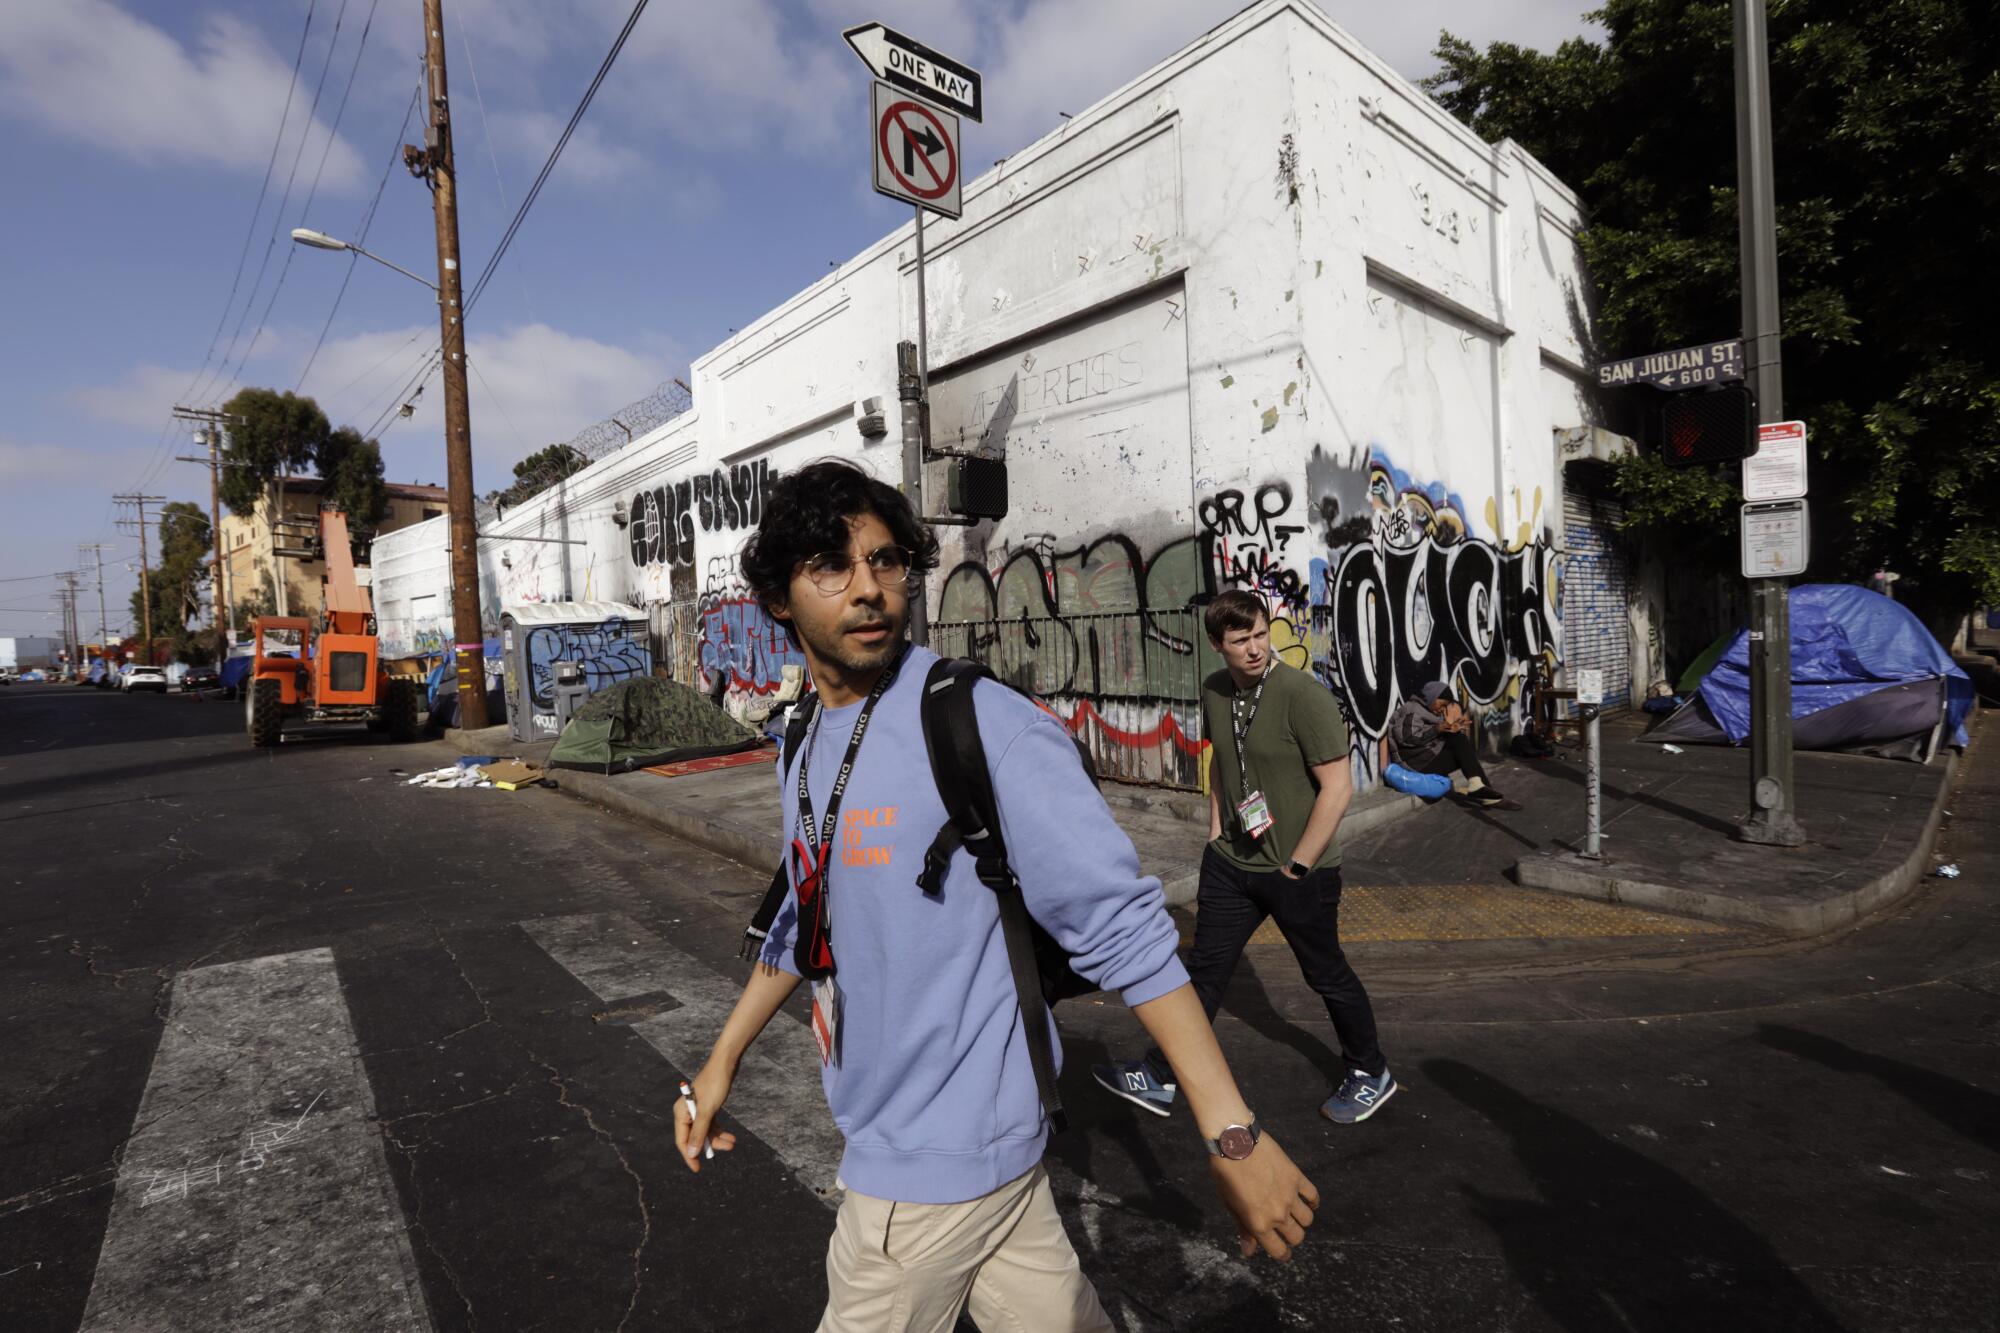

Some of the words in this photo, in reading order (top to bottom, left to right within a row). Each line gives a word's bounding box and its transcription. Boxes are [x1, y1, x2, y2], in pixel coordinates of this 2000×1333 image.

[889, 48, 926, 81] ONE
[933, 66, 969, 99] WAY
[1600, 362, 1634, 383] SAN
[1639, 348, 1704, 377] JULIAN
[1711, 342, 1741, 363] ST.
[1681, 366, 1715, 384] 600
[872, 670, 893, 698] DMH
[851, 713, 868, 745] DMH
[834, 763, 851, 796] DMH
[803, 814, 816, 846] DMH
[1125, 1071, 1148, 1091] N
[1353, 1084, 1378, 1107] N
